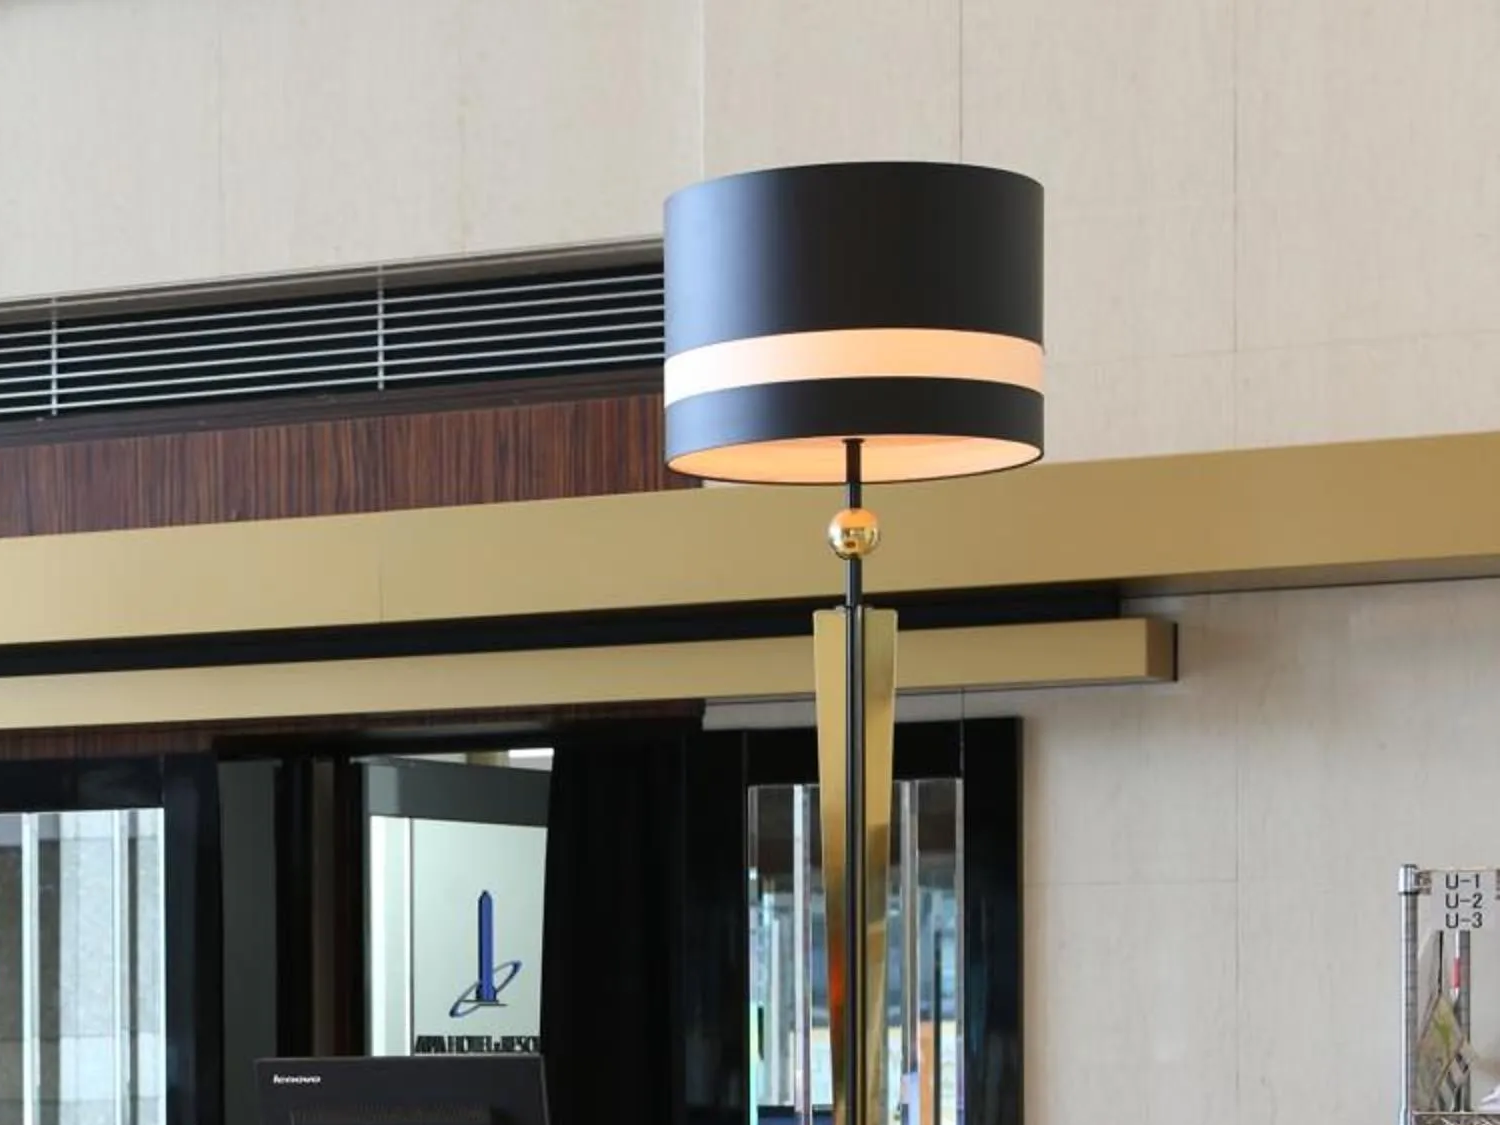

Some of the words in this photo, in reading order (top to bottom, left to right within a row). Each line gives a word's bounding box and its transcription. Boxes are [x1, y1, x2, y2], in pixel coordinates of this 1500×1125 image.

[1445, 872, 1480, 890] U-1
[1445, 892, 1483, 909] U-2
[1445, 911, 1483, 929] U-3
